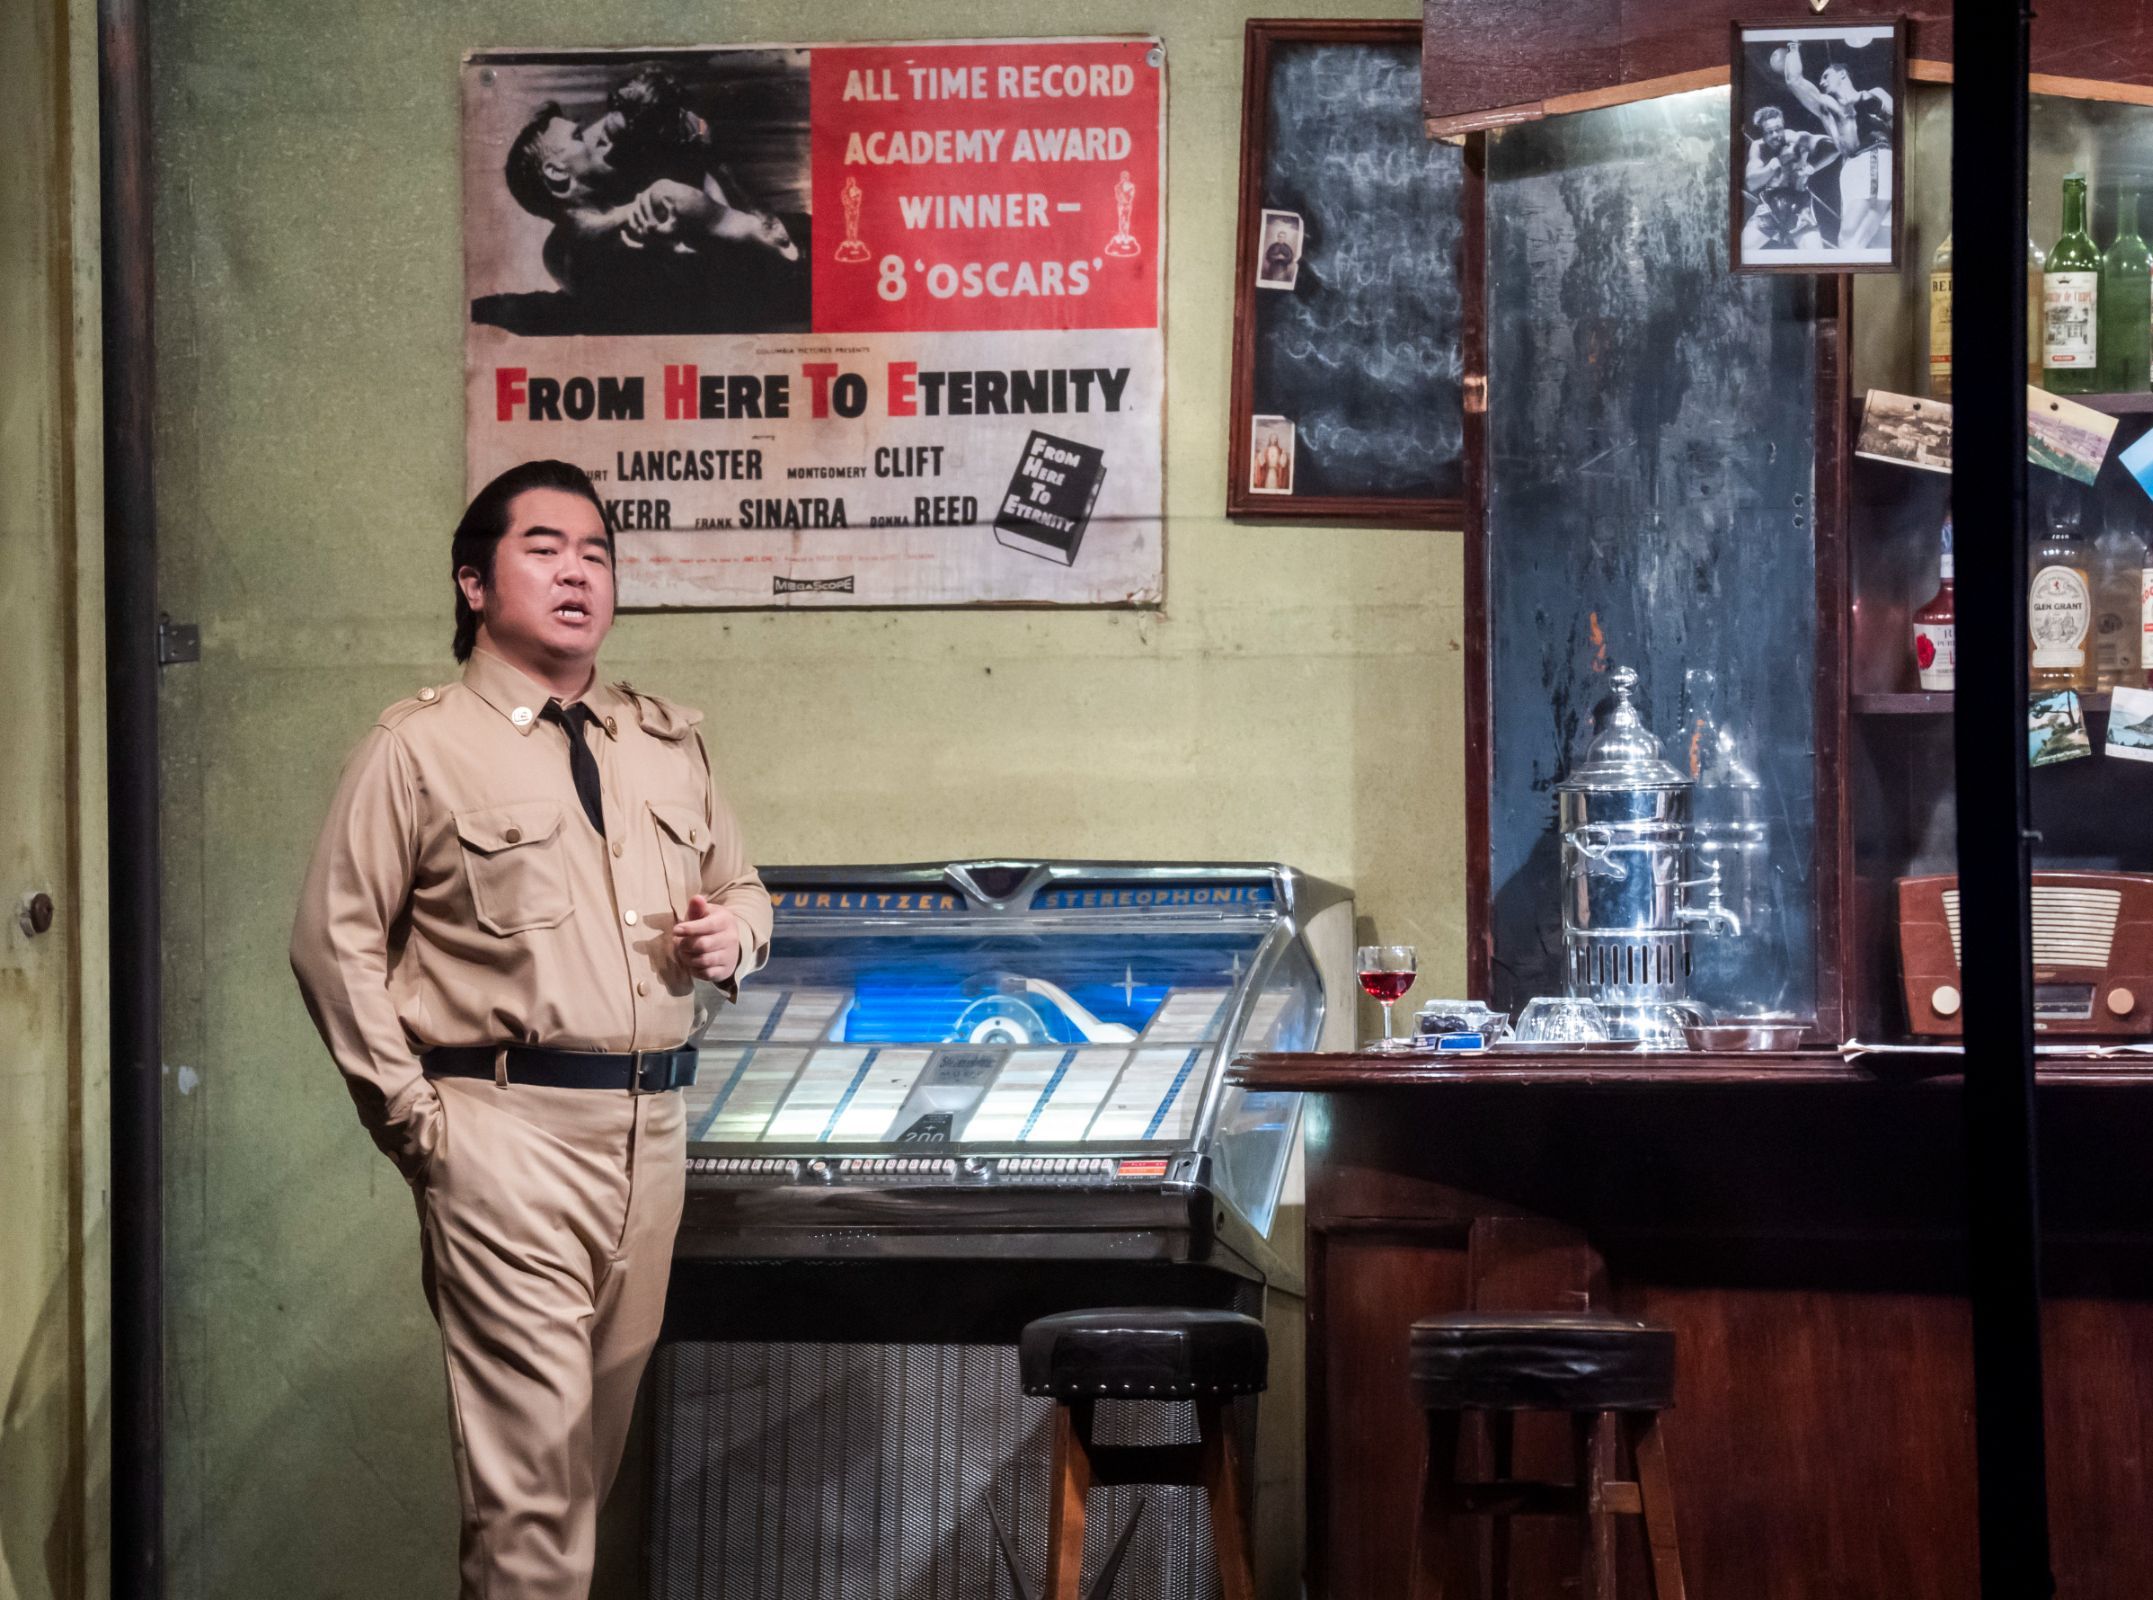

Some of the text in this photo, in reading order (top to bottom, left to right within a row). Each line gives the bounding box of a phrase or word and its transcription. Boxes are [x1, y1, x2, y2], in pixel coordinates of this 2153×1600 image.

[843, 64, 1134, 102] ALL TIME RECORD
[844, 128, 1131, 165] ACADEMY AWARD
[877, 254, 907, 301] 8
[496, 361, 1130, 421] FROM HERE TO ETERNITY
[617, 449, 763, 481] LANCASTER
[787, 446, 944, 480] MONTGOMERY CLIFT
[1031, 437, 1080, 468] FROM
[1022, 456, 1065, 486] HERE
[1029, 482, 1051, 505] TO
[605, 499, 671, 530] KERR
[695, 498, 848, 529] FRANK SINATRA
[870, 496, 978, 529] DONNA REED
[1003, 494, 1075, 532] ETERNITY
[1046, 887, 1259, 908] STEREOPHONIC
